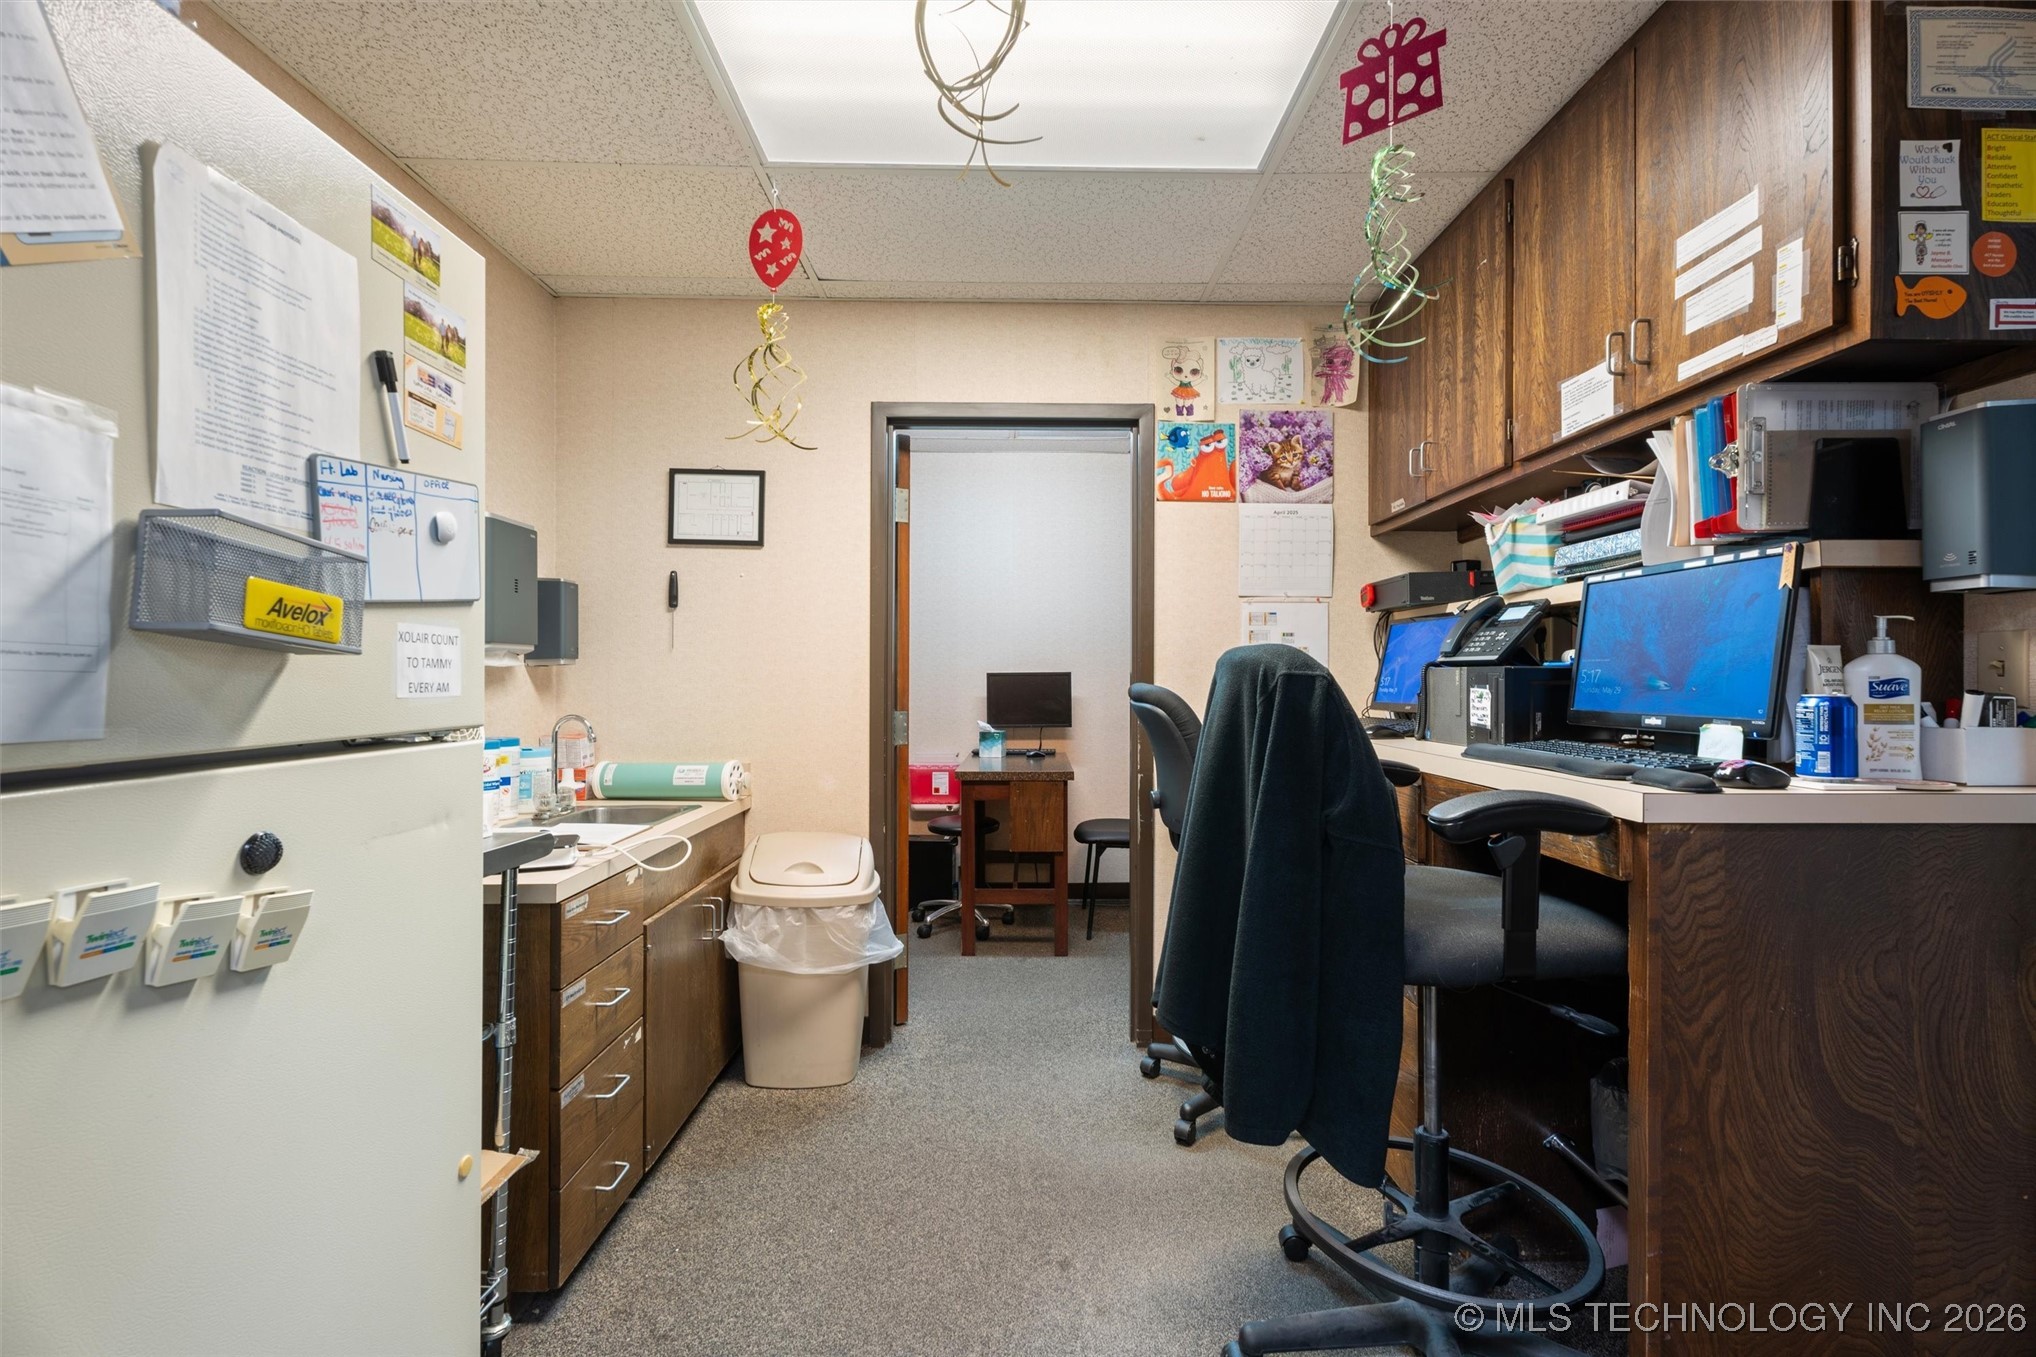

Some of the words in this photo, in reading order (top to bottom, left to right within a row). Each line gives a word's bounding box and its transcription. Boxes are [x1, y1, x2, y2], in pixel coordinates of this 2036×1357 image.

[1914, 144, 1940, 153] Work
[1987, 144, 2006, 152] Bright
[1900, 155, 1930, 164] Would
[1932, 155, 1955, 164] Suck
[1909, 165, 1946, 174] Without
[1918, 175, 1937, 185] You
[1987, 209, 2022, 217] Thoughtful
[339, 461, 359, 477] Lab
[372, 468, 406, 491] Nursing
[1201, 490, 1210, 498] NO
[265, 596, 329, 626] Avelox
[398, 630, 429, 645] XOLAIR
[431, 632, 459, 647] COUNT
[406, 656, 419, 669] TO
[421, 656, 453, 670] TAMMY
[1817, 663, 1844, 676] JERGEN
[1580, 668, 1602, 684] 5:17
[408, 682, 434, 694] EVERY
[436, 682, 450, 693] AM
[1871, 681, 1908, 691] Suave
